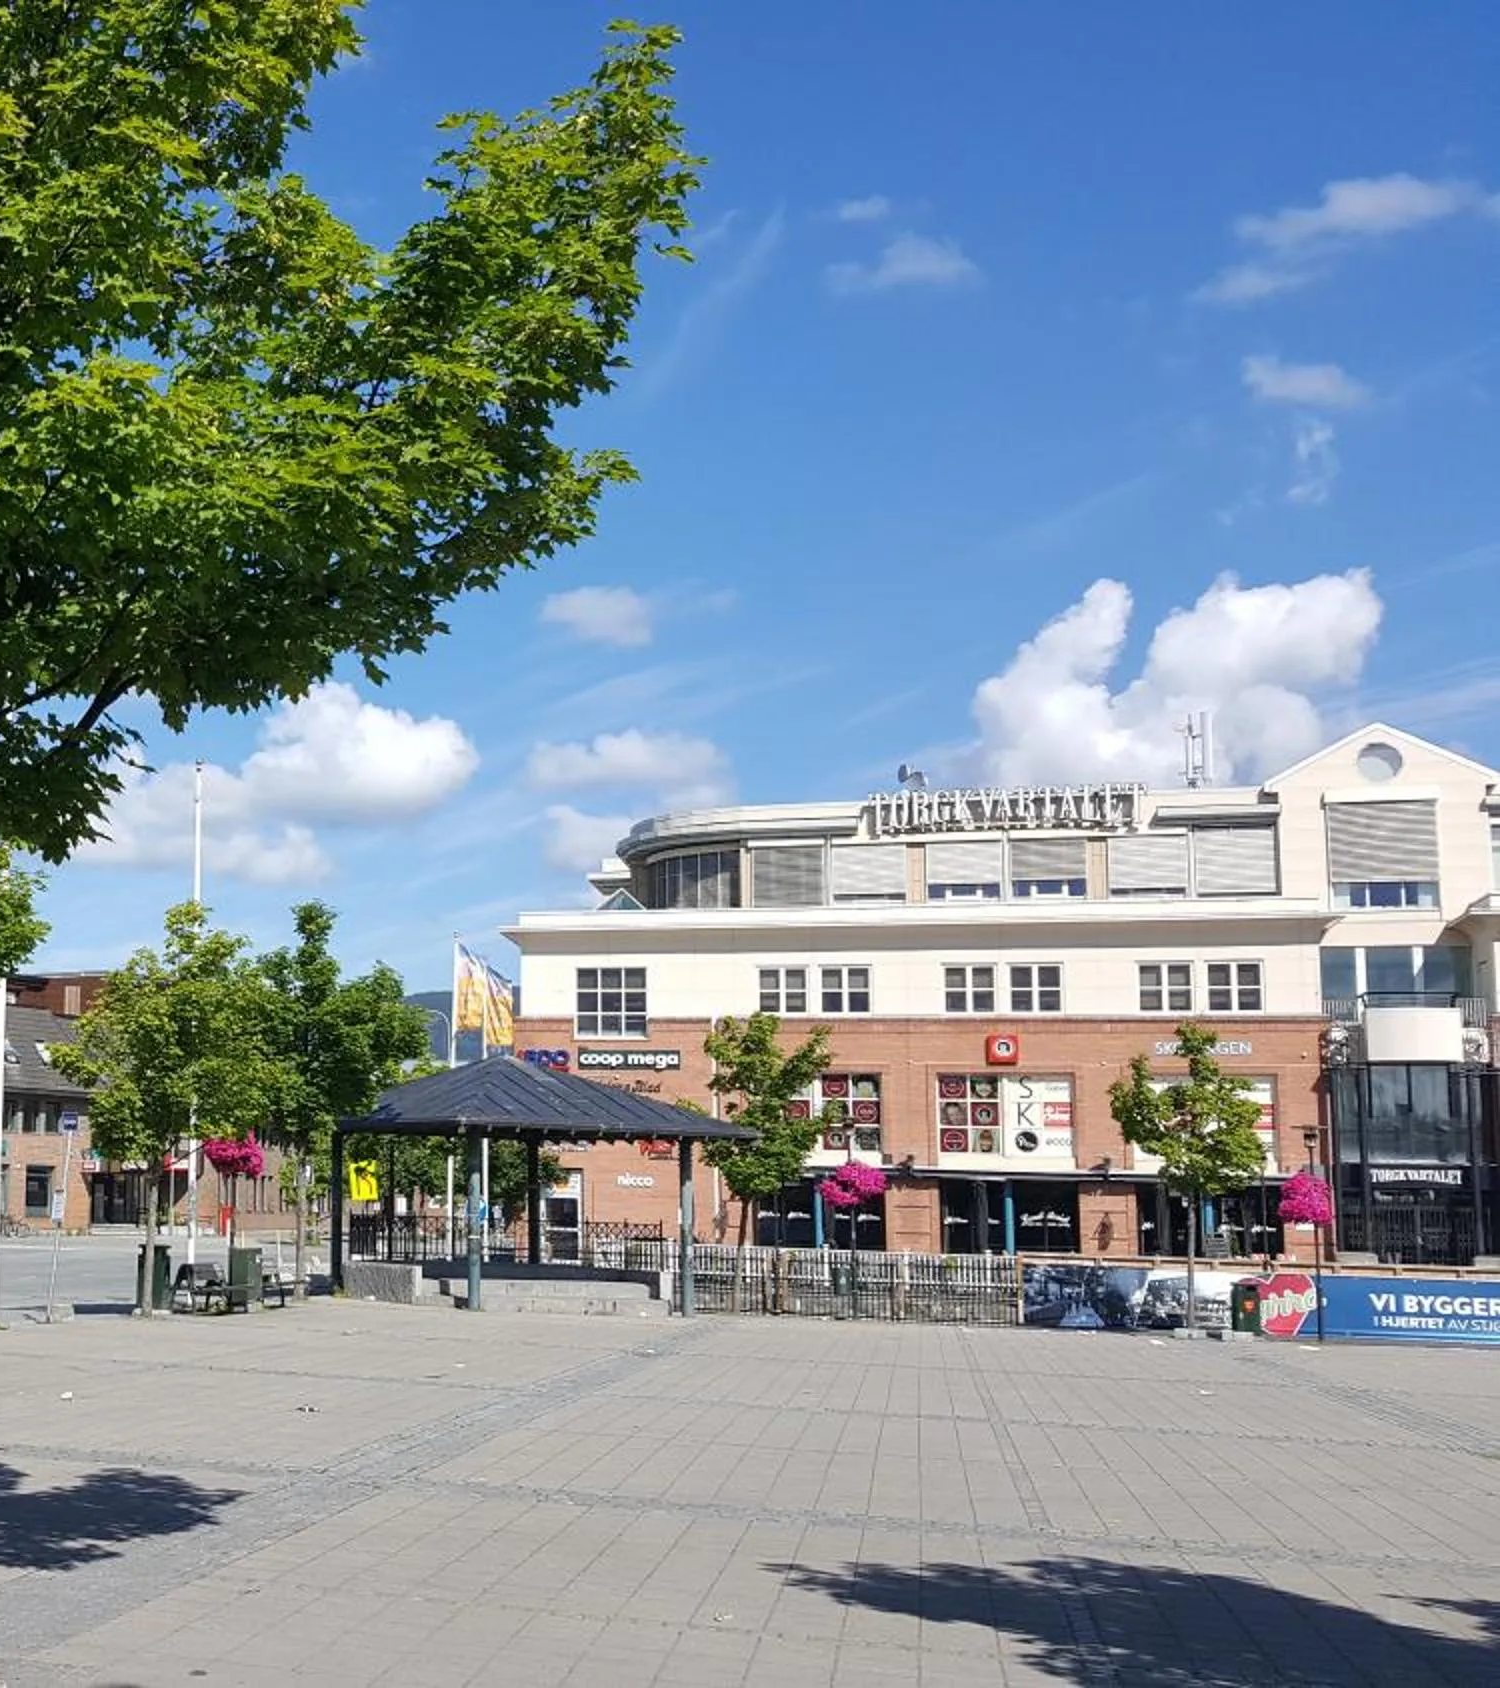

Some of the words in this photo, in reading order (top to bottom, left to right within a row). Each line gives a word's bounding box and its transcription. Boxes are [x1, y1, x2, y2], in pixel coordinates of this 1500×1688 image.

[870, 785, 1147, 831] TORGKVARTALET
[1155, 1041, 1252, 1055] SKONGEN
[580, 1053, 624, 1067] coop
[628, 1053, 679, 1069] mega
[1369, 1168, 1463, 1185] TORGKVARTALET
[1368, 1293, 1397, 1313] VI
[1381, 1316, 1445, 1329] HJERTET
[1447, 1318, 1468, 1331] AV
